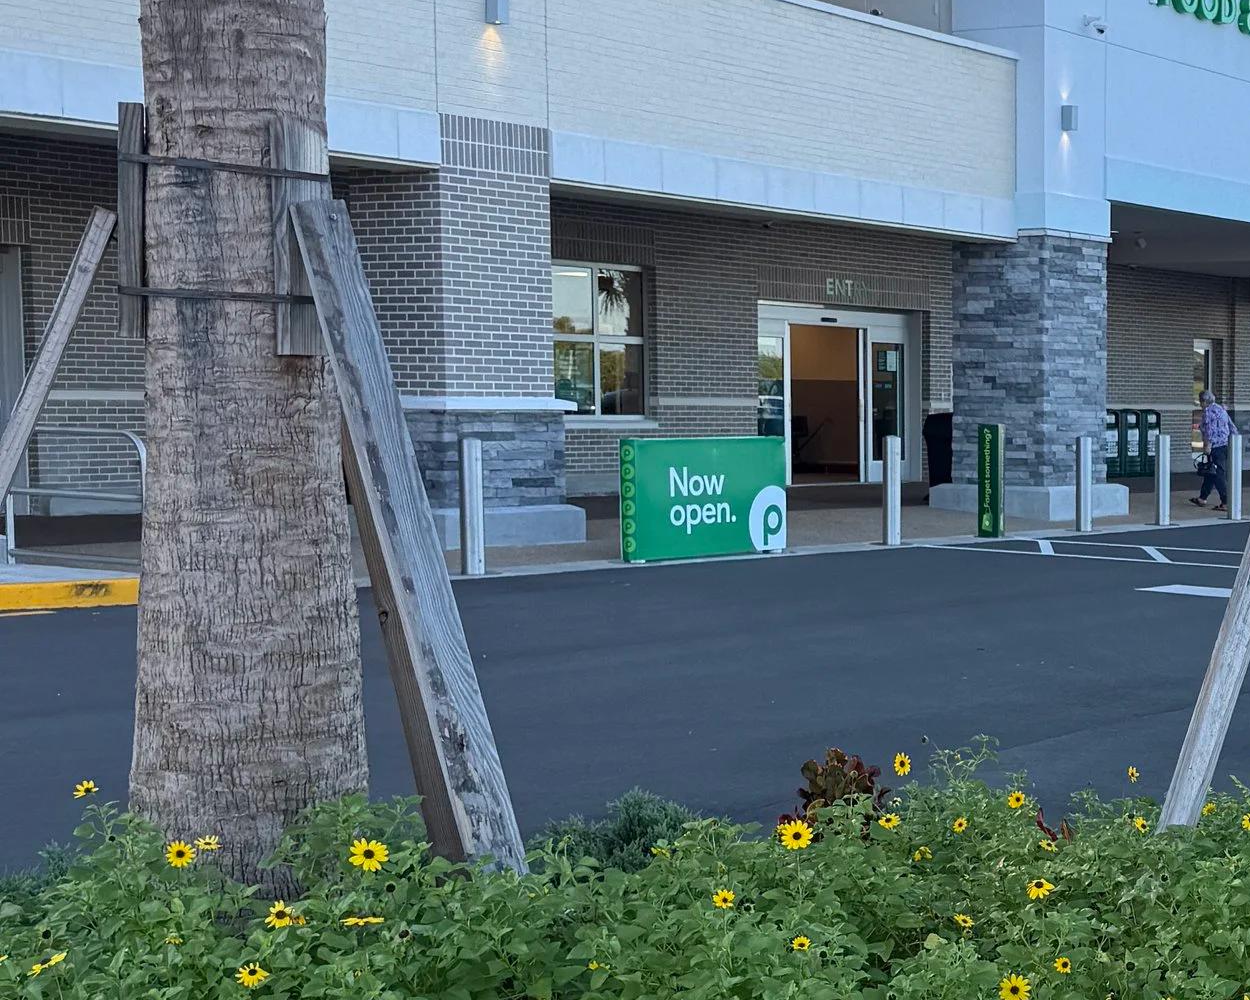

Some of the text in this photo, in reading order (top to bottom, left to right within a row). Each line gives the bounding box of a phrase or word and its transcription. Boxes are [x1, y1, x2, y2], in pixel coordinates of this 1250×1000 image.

[826, 278, 870, 299] ENTRY
[669, 466, 725, 498] Now
[983, 428, 992, 508] Forget something?
[669, 502, 737, 535] open.
